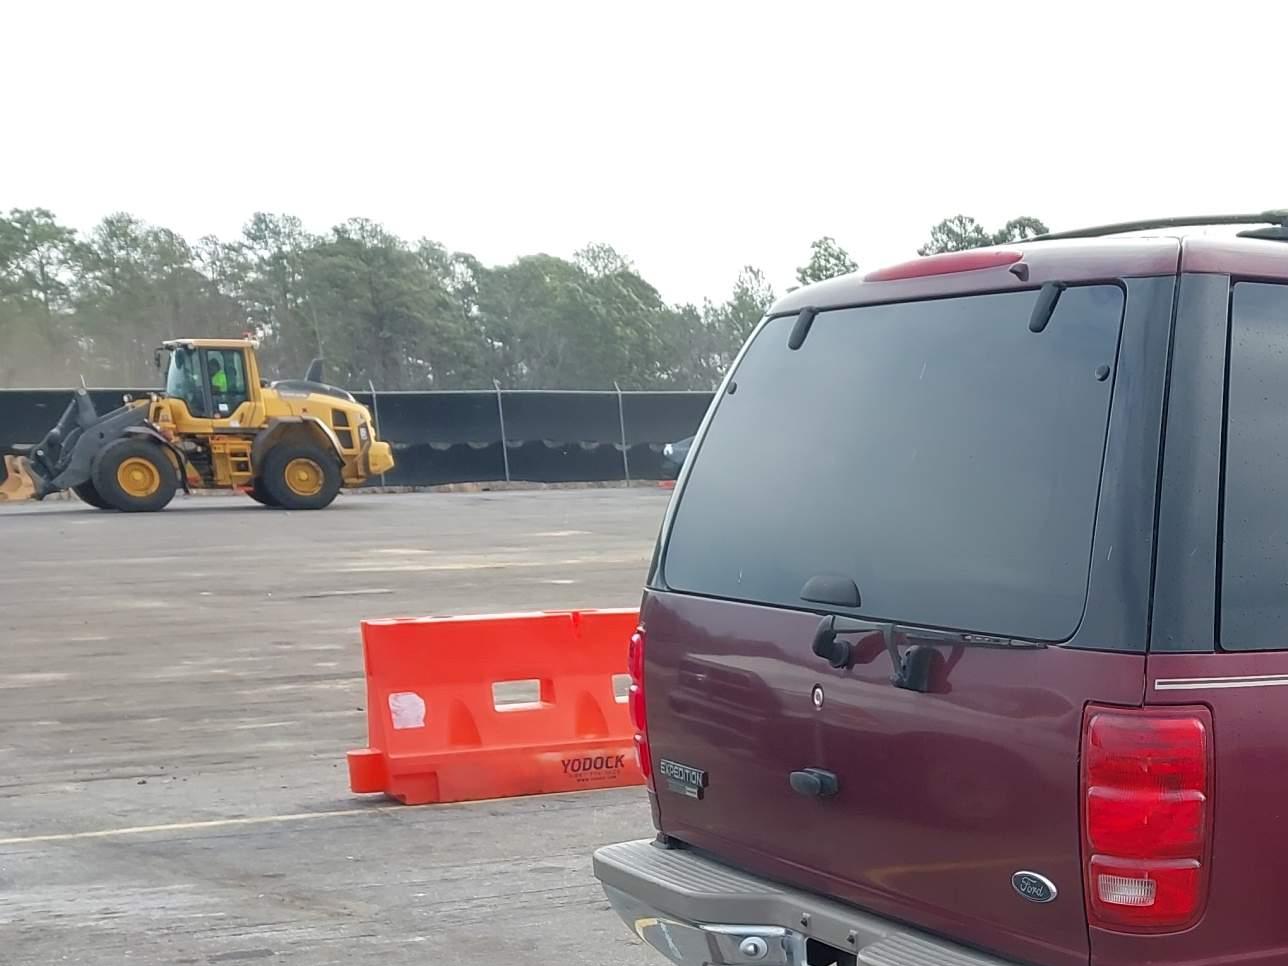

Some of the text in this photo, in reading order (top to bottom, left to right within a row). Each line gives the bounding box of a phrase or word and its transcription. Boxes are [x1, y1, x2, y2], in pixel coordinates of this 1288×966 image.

[561, 754, 625, 774] YODOCK
[660, 761, 703, 787] EXPEDITION
[1020, 876, 1045, 897] Ford
